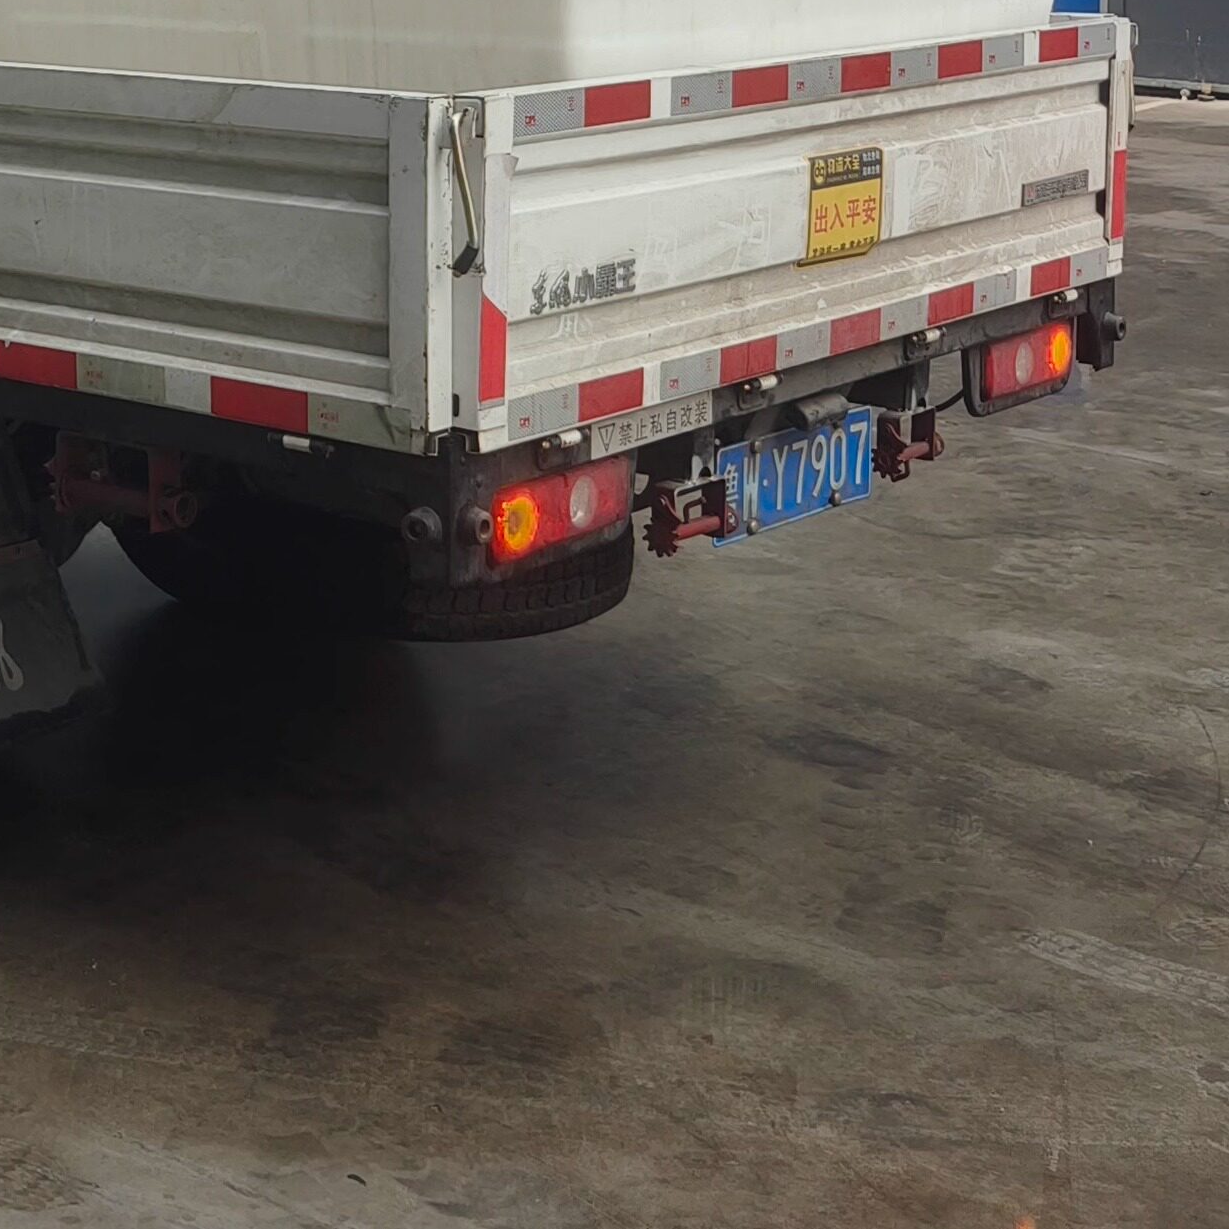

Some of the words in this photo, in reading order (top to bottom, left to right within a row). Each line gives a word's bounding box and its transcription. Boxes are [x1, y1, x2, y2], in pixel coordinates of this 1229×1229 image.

[814, 195, 877, 233] 出入平安
[618, 398, 709, 447] 禁止私自改装
